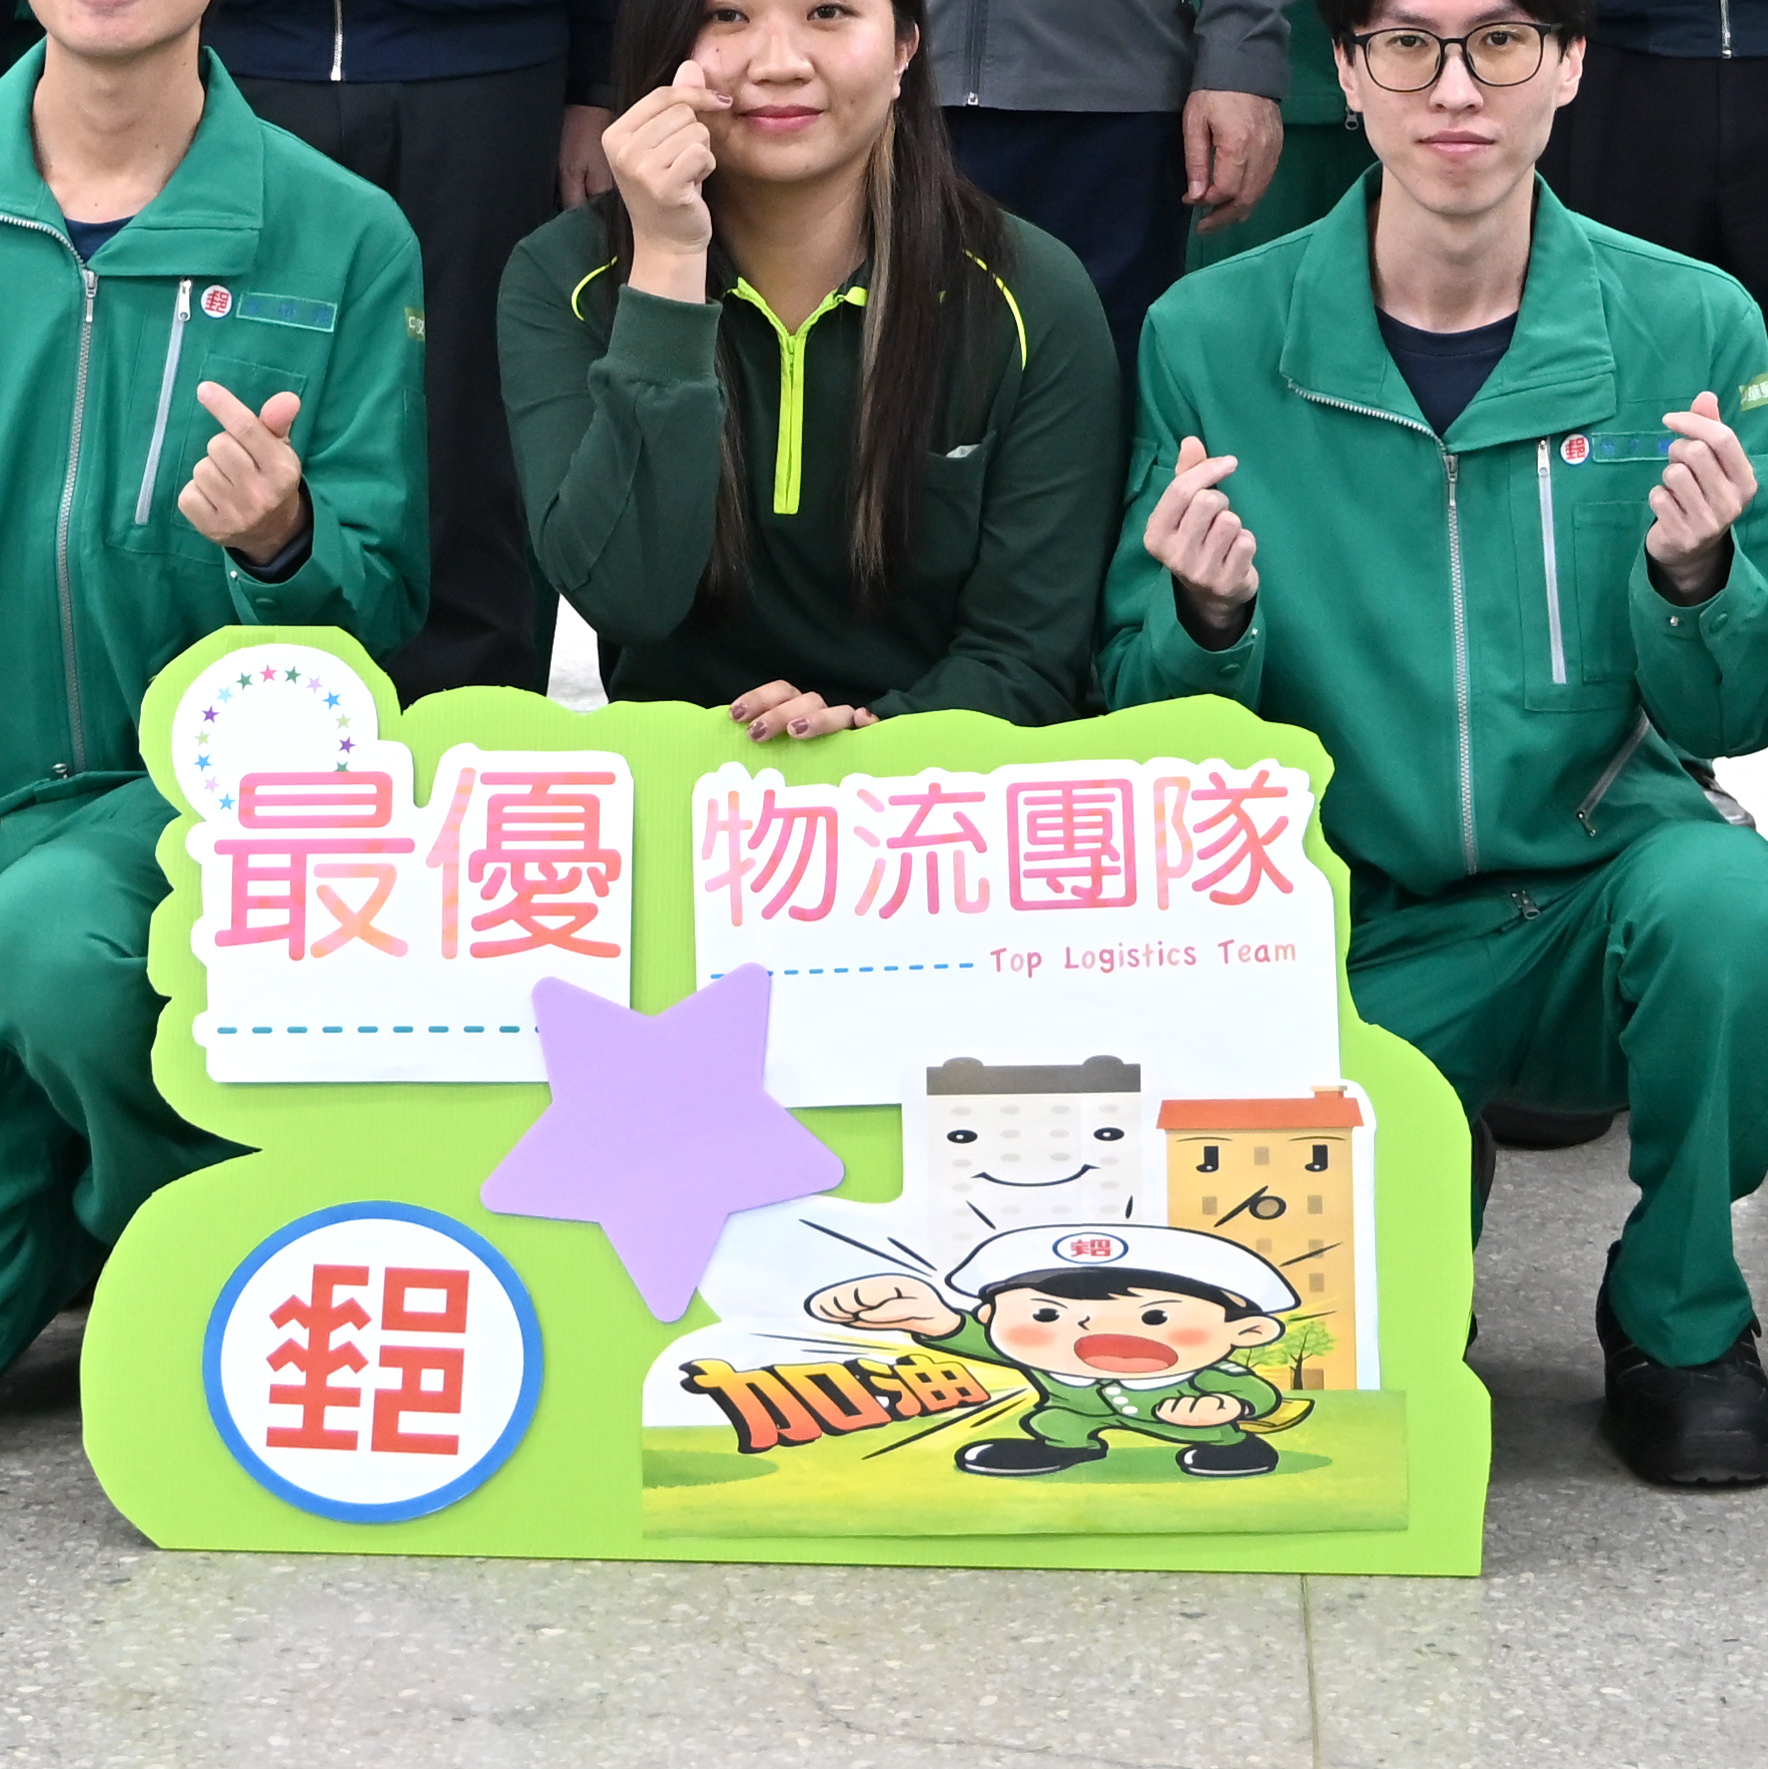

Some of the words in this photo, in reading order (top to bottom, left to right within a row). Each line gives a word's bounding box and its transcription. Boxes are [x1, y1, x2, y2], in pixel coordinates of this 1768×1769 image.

[213, 767, 622, 961] 最優
[701, 769, 1295, 927] 物流團隊
[989, 946, 1043, 978] Top
[1063, 940, 1198, 974] Logistics
[1217, 938, 1297, 964] Team
[265, 1264, 473, 1456] 郵
[678, 1353, 991, 1454] 加油
